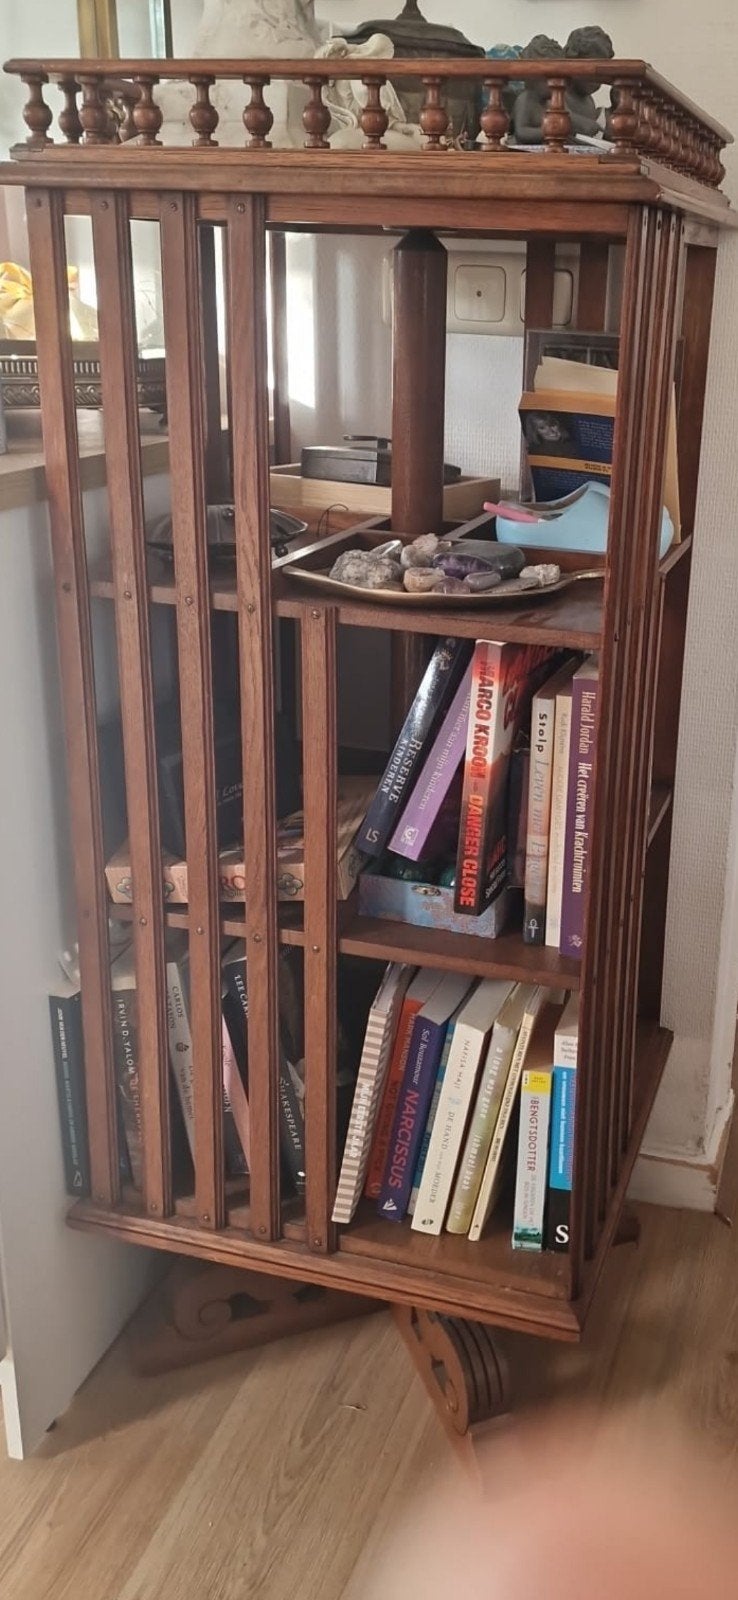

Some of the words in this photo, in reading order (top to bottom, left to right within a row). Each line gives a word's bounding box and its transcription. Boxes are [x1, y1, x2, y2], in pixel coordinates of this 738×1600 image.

[476, 661, 494, 720] MARCO
[581, 690, 596, 722] Harald
[536, 713, 548, 753] Stolp
[579, 723, 594, 754] Jordan
[381, 738, 409, 794] KINDEREN
[435, 747, 453, 771] mijn
[471, 724, 491, 779] KROON
[388, 736, 423, 804] RESERVE
[535, 759, 549, 801] Leven
[577, 761, 592, 779] Het
[417, 769, 443, 810] kinderen
[576, 779, 590, 813] creëren
[365, 827, 381, 843] LS
[464, 794, 482, 856] DANGER
[576, 813, 586, 829] van
[571, 830, 588, 893] Krachtruimten
[460, 858, 478, 907] CLOSE
[234, 974, 244, 993] LEE
[117, 998, 127, 1027] IRVIN
[172, 985, 184, 1018] CARLOS
[122, 1030, 130, 1041] D.
[421, 1028, 430, 1042] Sol
[124, 1041, 136, 1075] YALOM
[398, 1036, 413, 1071] MANSON
[447, 1111, 456, 1123] DE
[388, 1089, 420, 1189] NARCISSUS
[442, 1123, 454, 1150] HAND
[526, 1099, 539, 1172] BENGTSDOTTER
[555, 1224, 570, 1244] S
